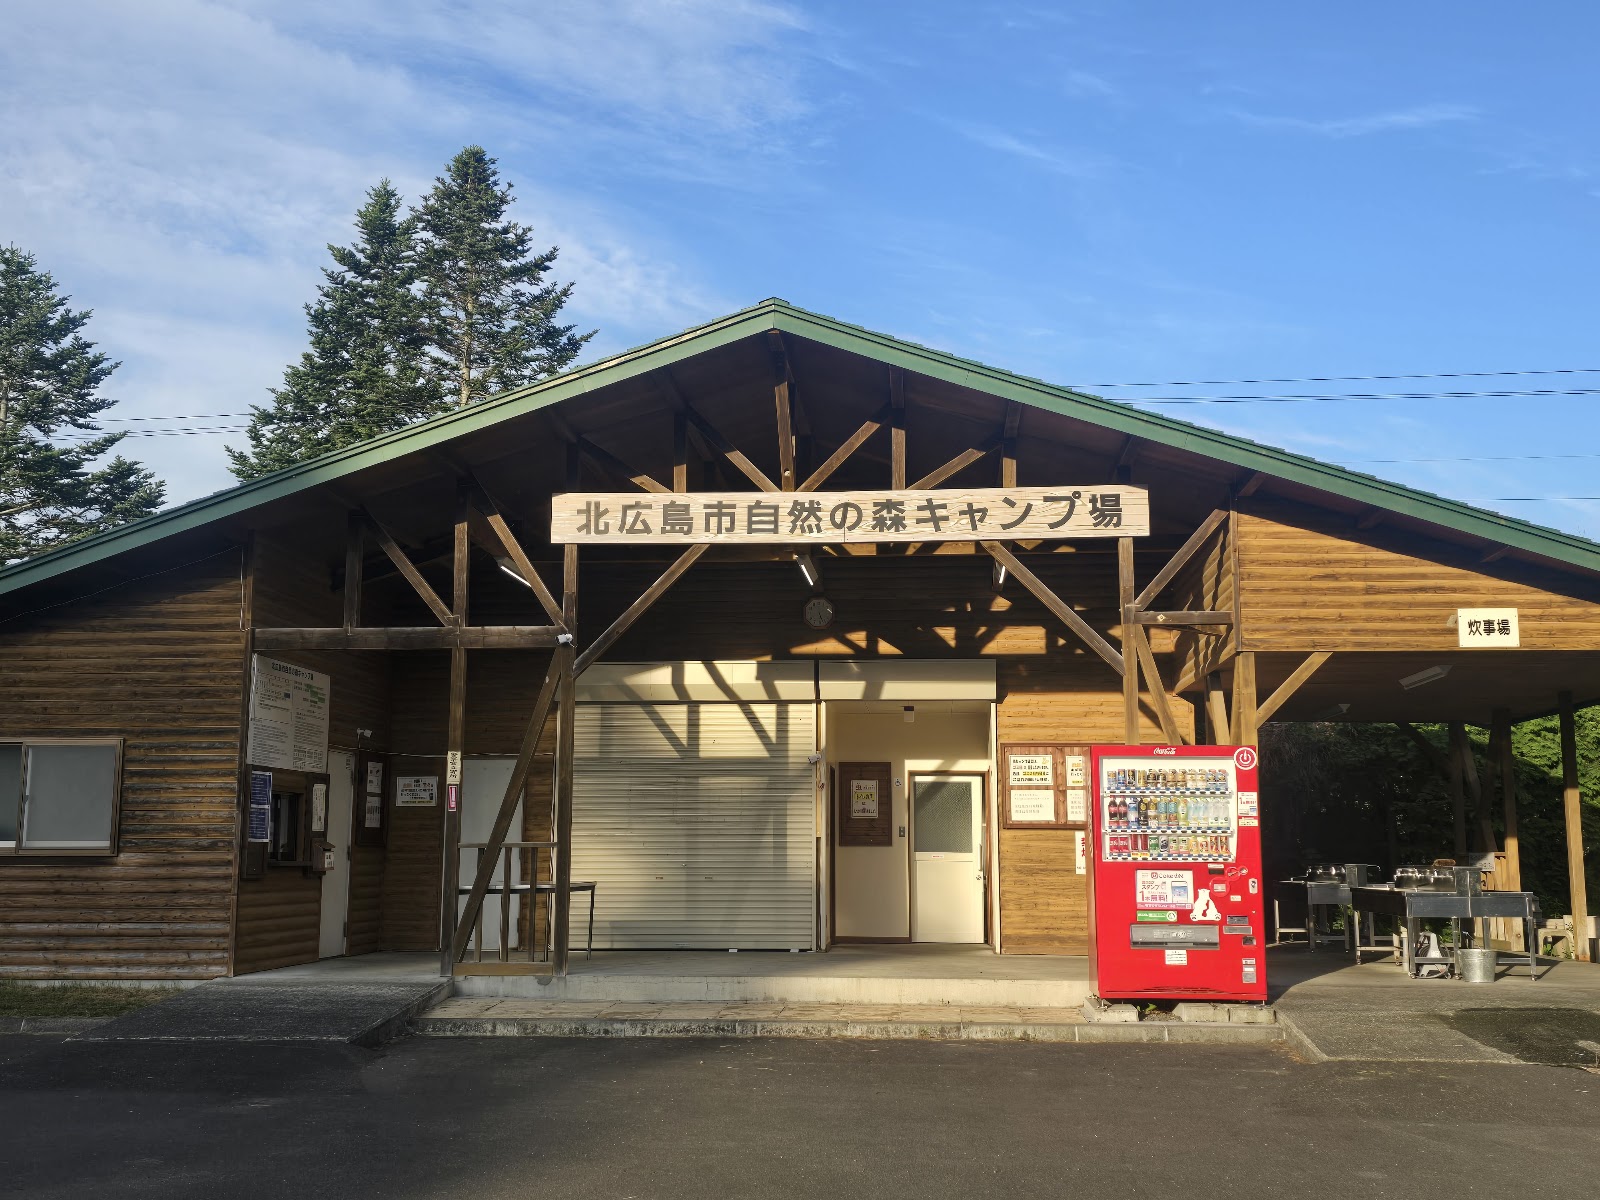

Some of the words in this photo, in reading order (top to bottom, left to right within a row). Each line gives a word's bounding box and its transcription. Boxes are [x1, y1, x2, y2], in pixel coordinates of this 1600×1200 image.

[577, 491, 1123, 535] 北広島市自然の森キャンプ場
[1468, 619, 1511, 636] 炊事場
